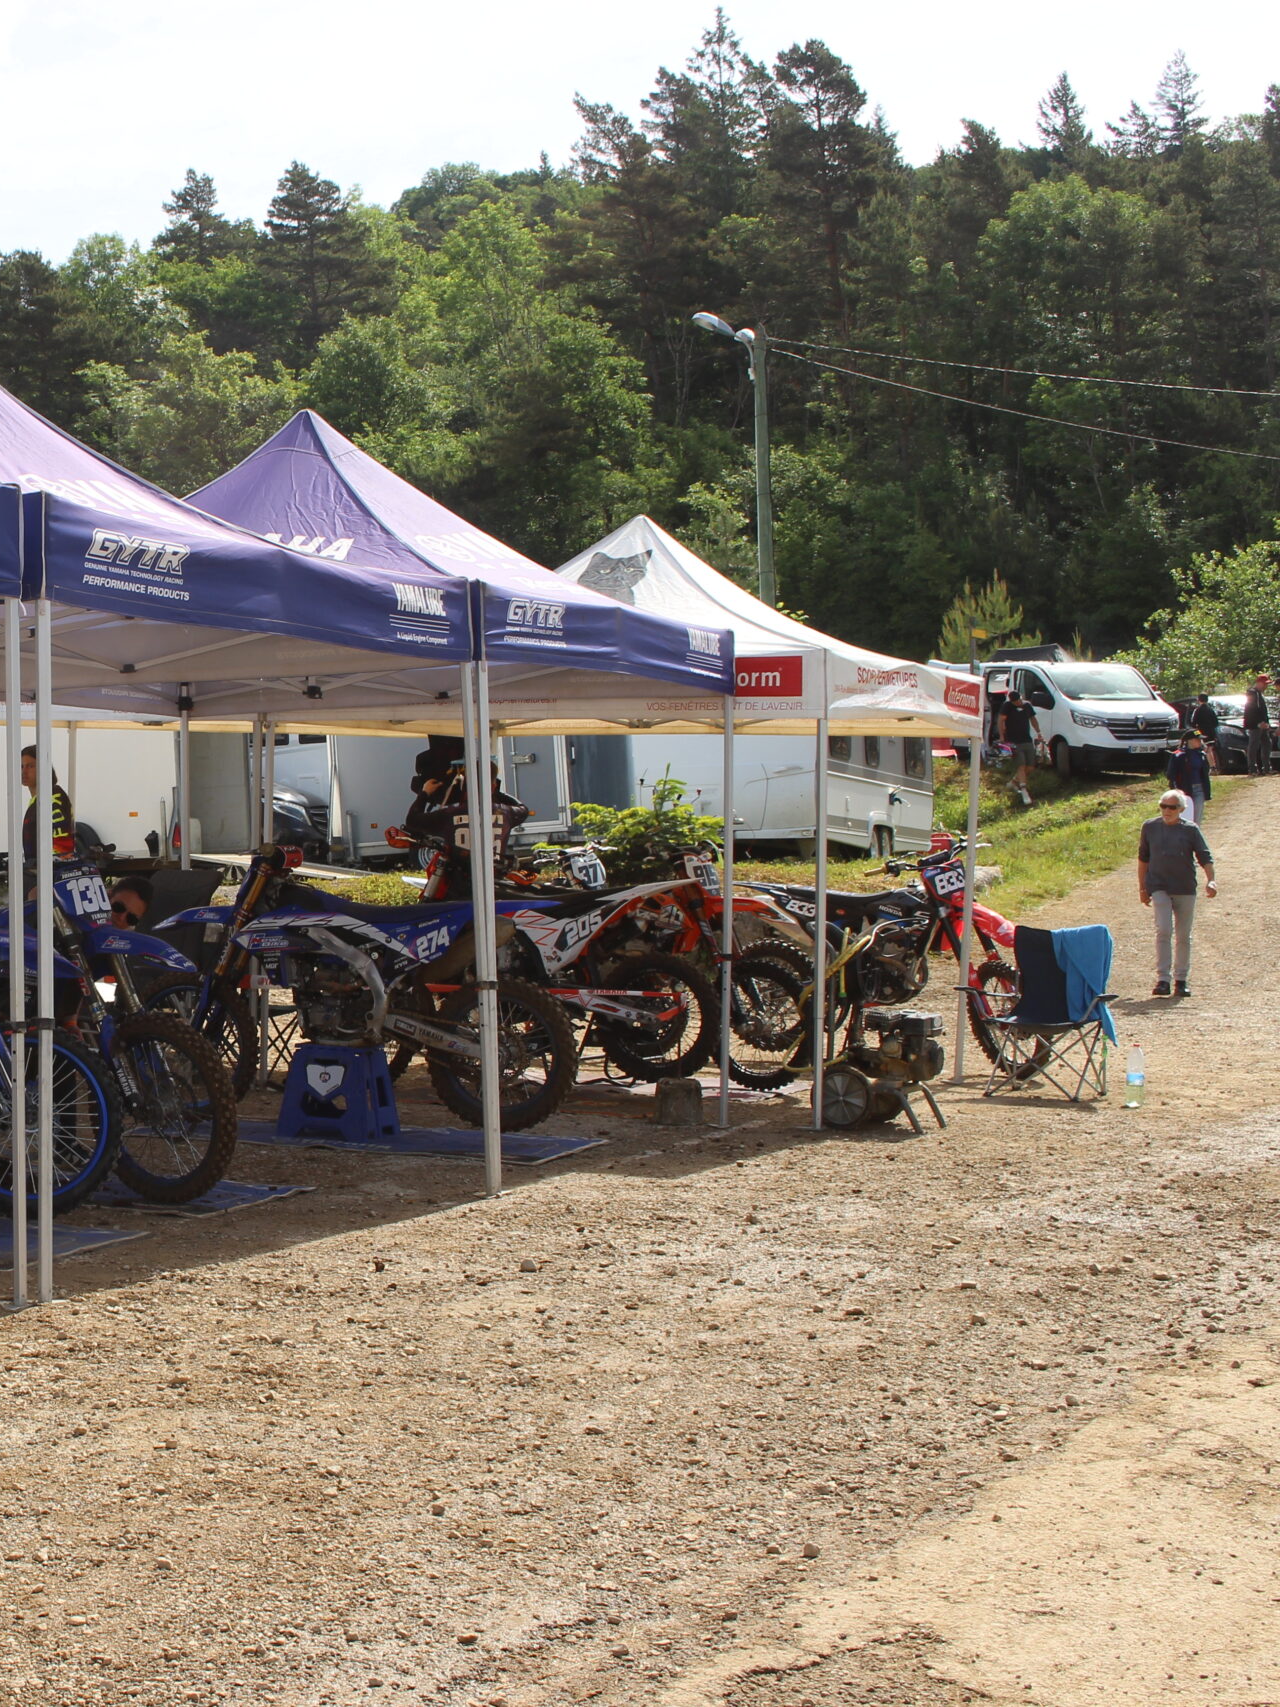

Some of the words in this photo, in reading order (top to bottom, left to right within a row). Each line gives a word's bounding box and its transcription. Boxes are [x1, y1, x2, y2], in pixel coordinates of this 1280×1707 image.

[85, 528, 190, 575] GYTR
[84, 561, 108, 572] GENUINE
[108, 566, 130, 576] YAMAHA
[130, 570, 165, 583] TECHNOLOGY
[82, 574, 146, 594] PERFORMANCE
[147, 586, 190, 601] PRODUCTS
[392, 582, 446, 617] YAMALUBE
[506, 598, 566, 628] GYTR
[646, 702, 666, 711] VOS
[745, 702, 759, 711] DE
[66, 876, 112, 916] 130
[786, 899, 816, 918] 833
[878, 904, 903, 917] HONDA
[564, 911, 604, 943] 205
[416, 925, 450, 960] 274
